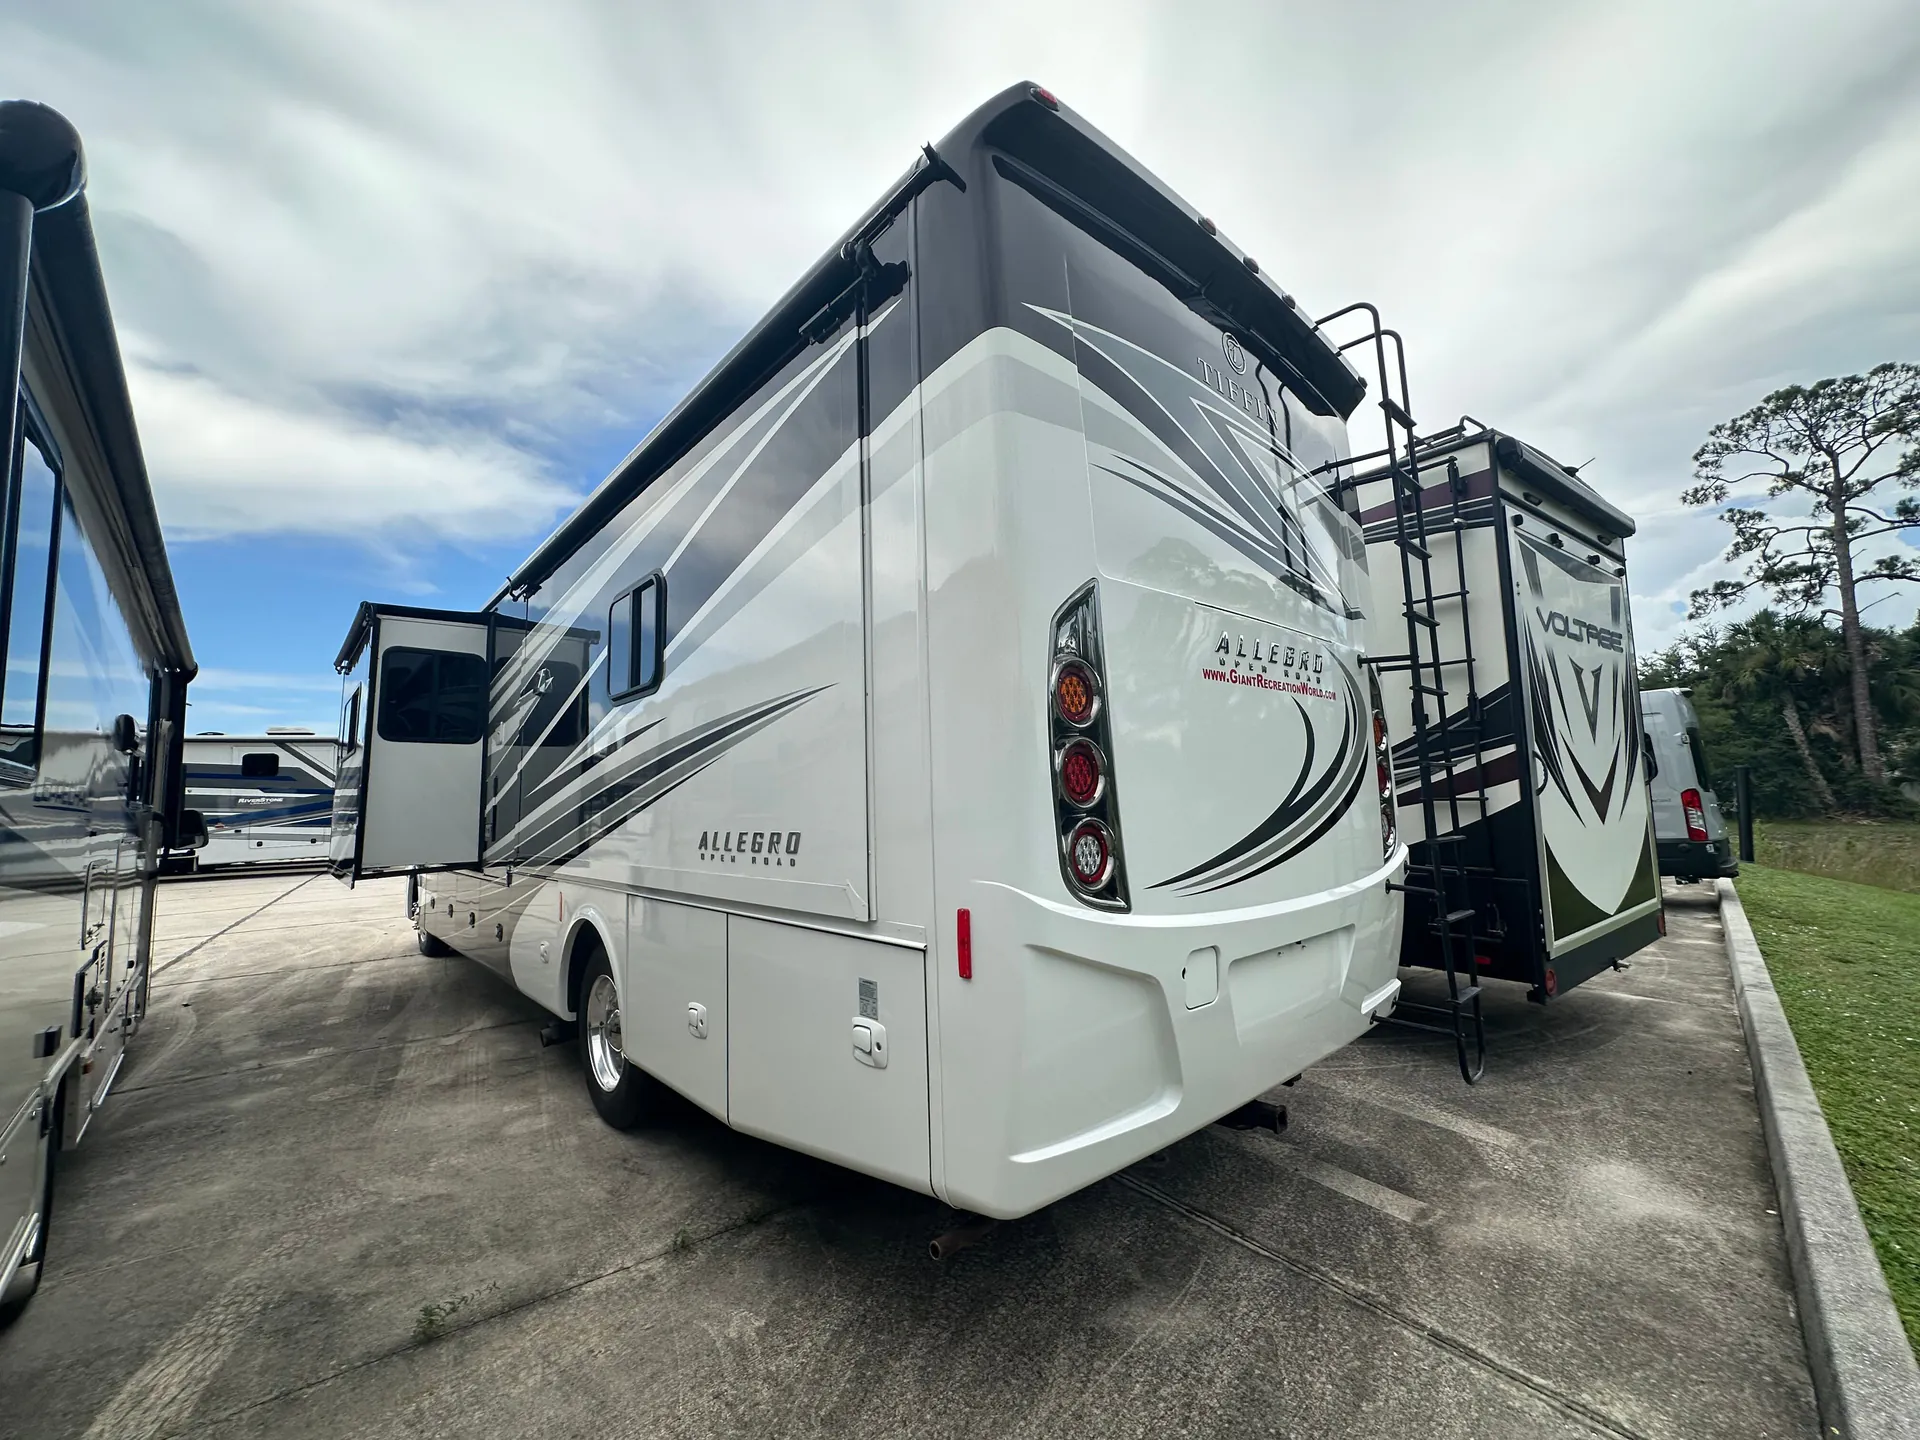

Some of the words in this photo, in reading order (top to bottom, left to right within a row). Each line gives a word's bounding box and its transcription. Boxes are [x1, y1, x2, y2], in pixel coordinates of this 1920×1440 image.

[1197, 357, 1279, 430] TIFFIN
[1214, 630, 1324, 674] ALLEGRO
[698, 830, 801, 855] ALLEGRO
[700, 853, 736, 863] OPEN
[751, 856, 796, 867] ROAD
